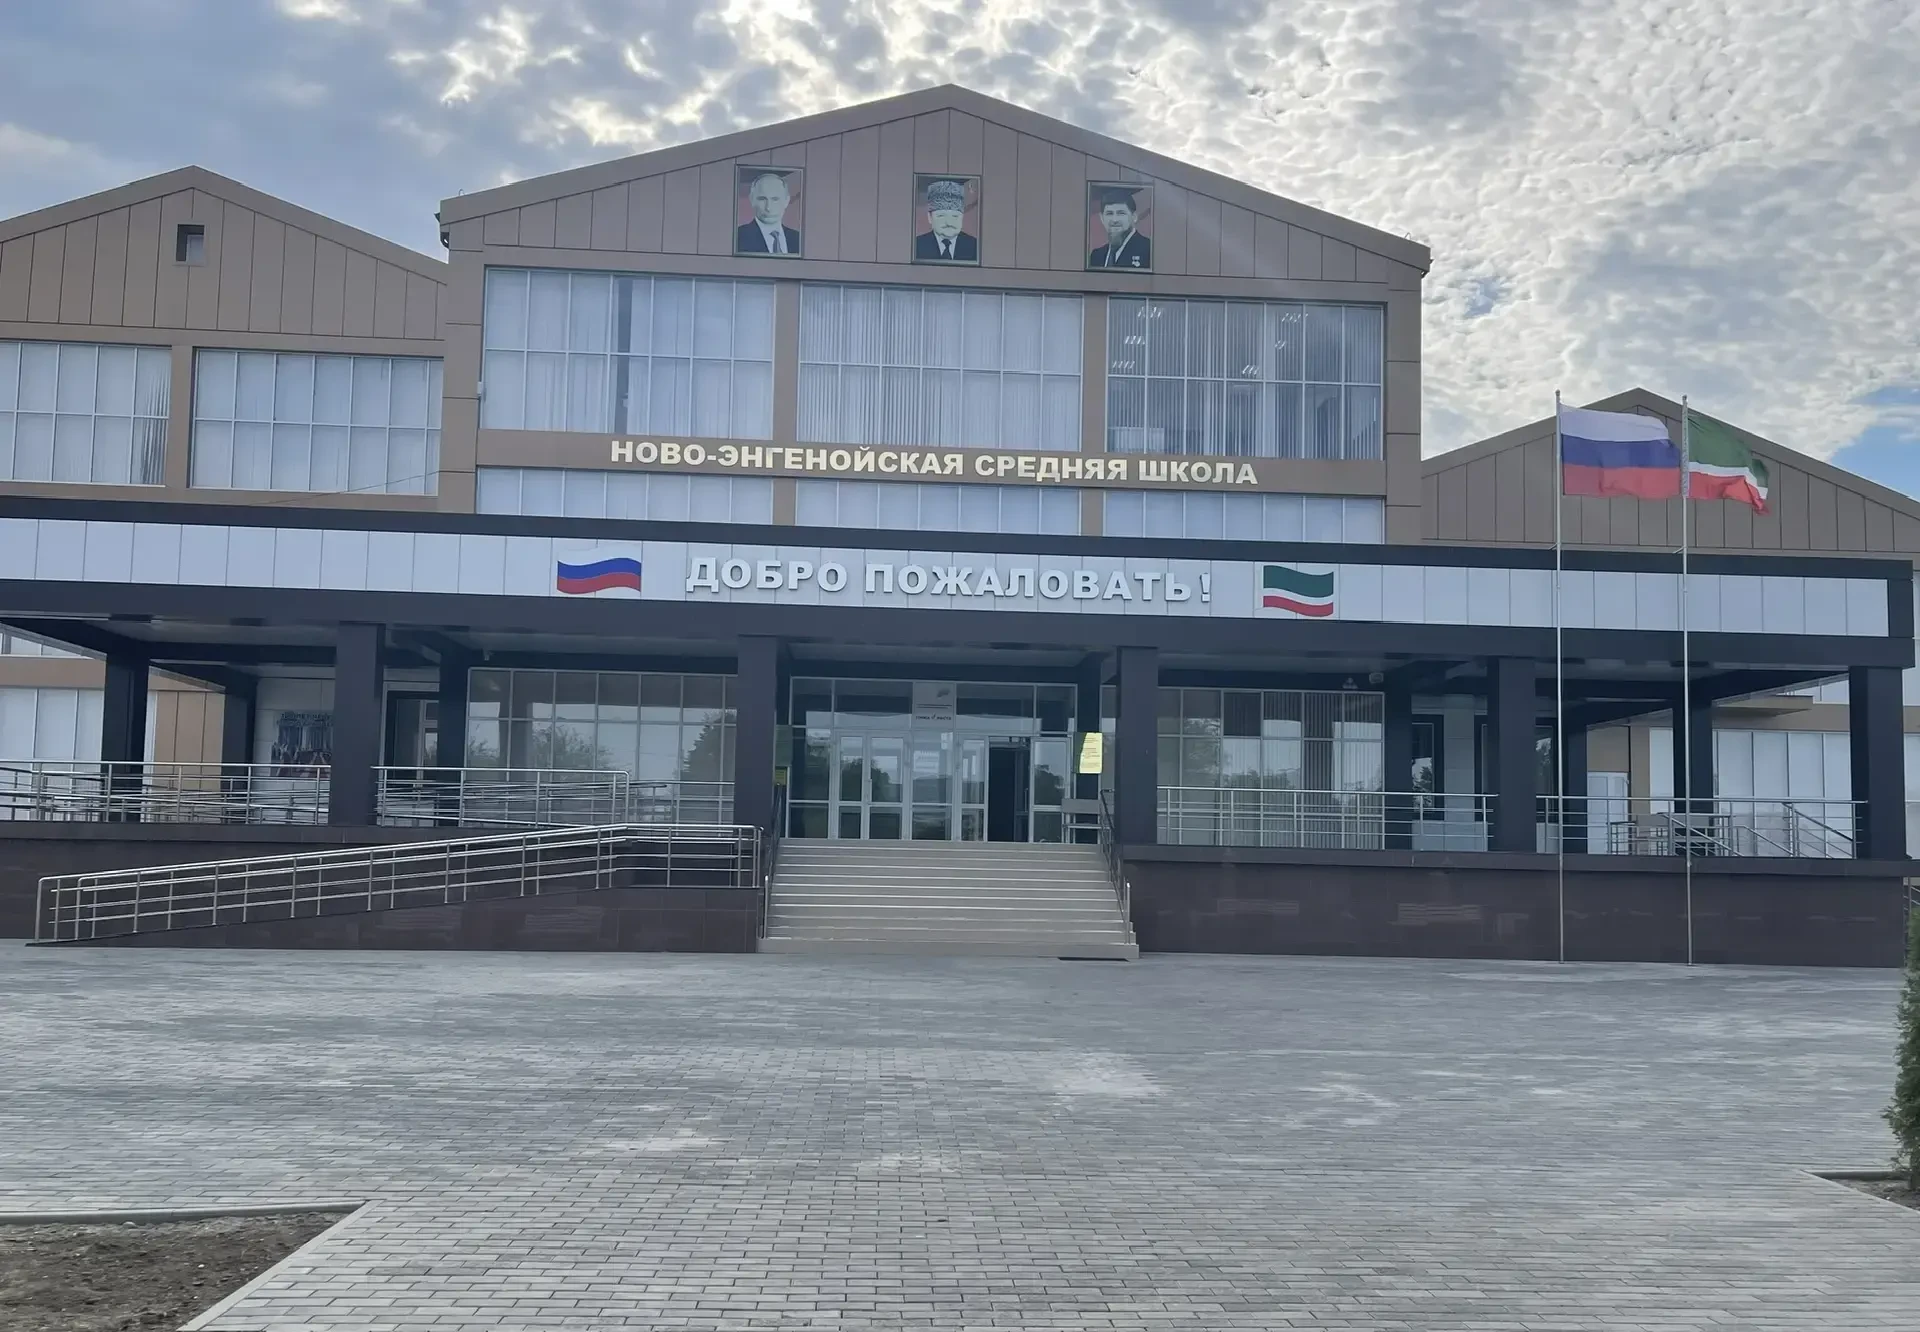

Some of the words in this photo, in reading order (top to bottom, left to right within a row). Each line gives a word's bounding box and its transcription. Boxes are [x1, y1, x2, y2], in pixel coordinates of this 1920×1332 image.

[610, 440, 964, 476] НОВО-ЭНГЕНОЙСКАЯ
[974, 454, 1128, 483] СРЕДНЯЯ
[1138, 459, 1258, 485] ШКОЛА
[685, 556, 848, 593] ДОБРО
